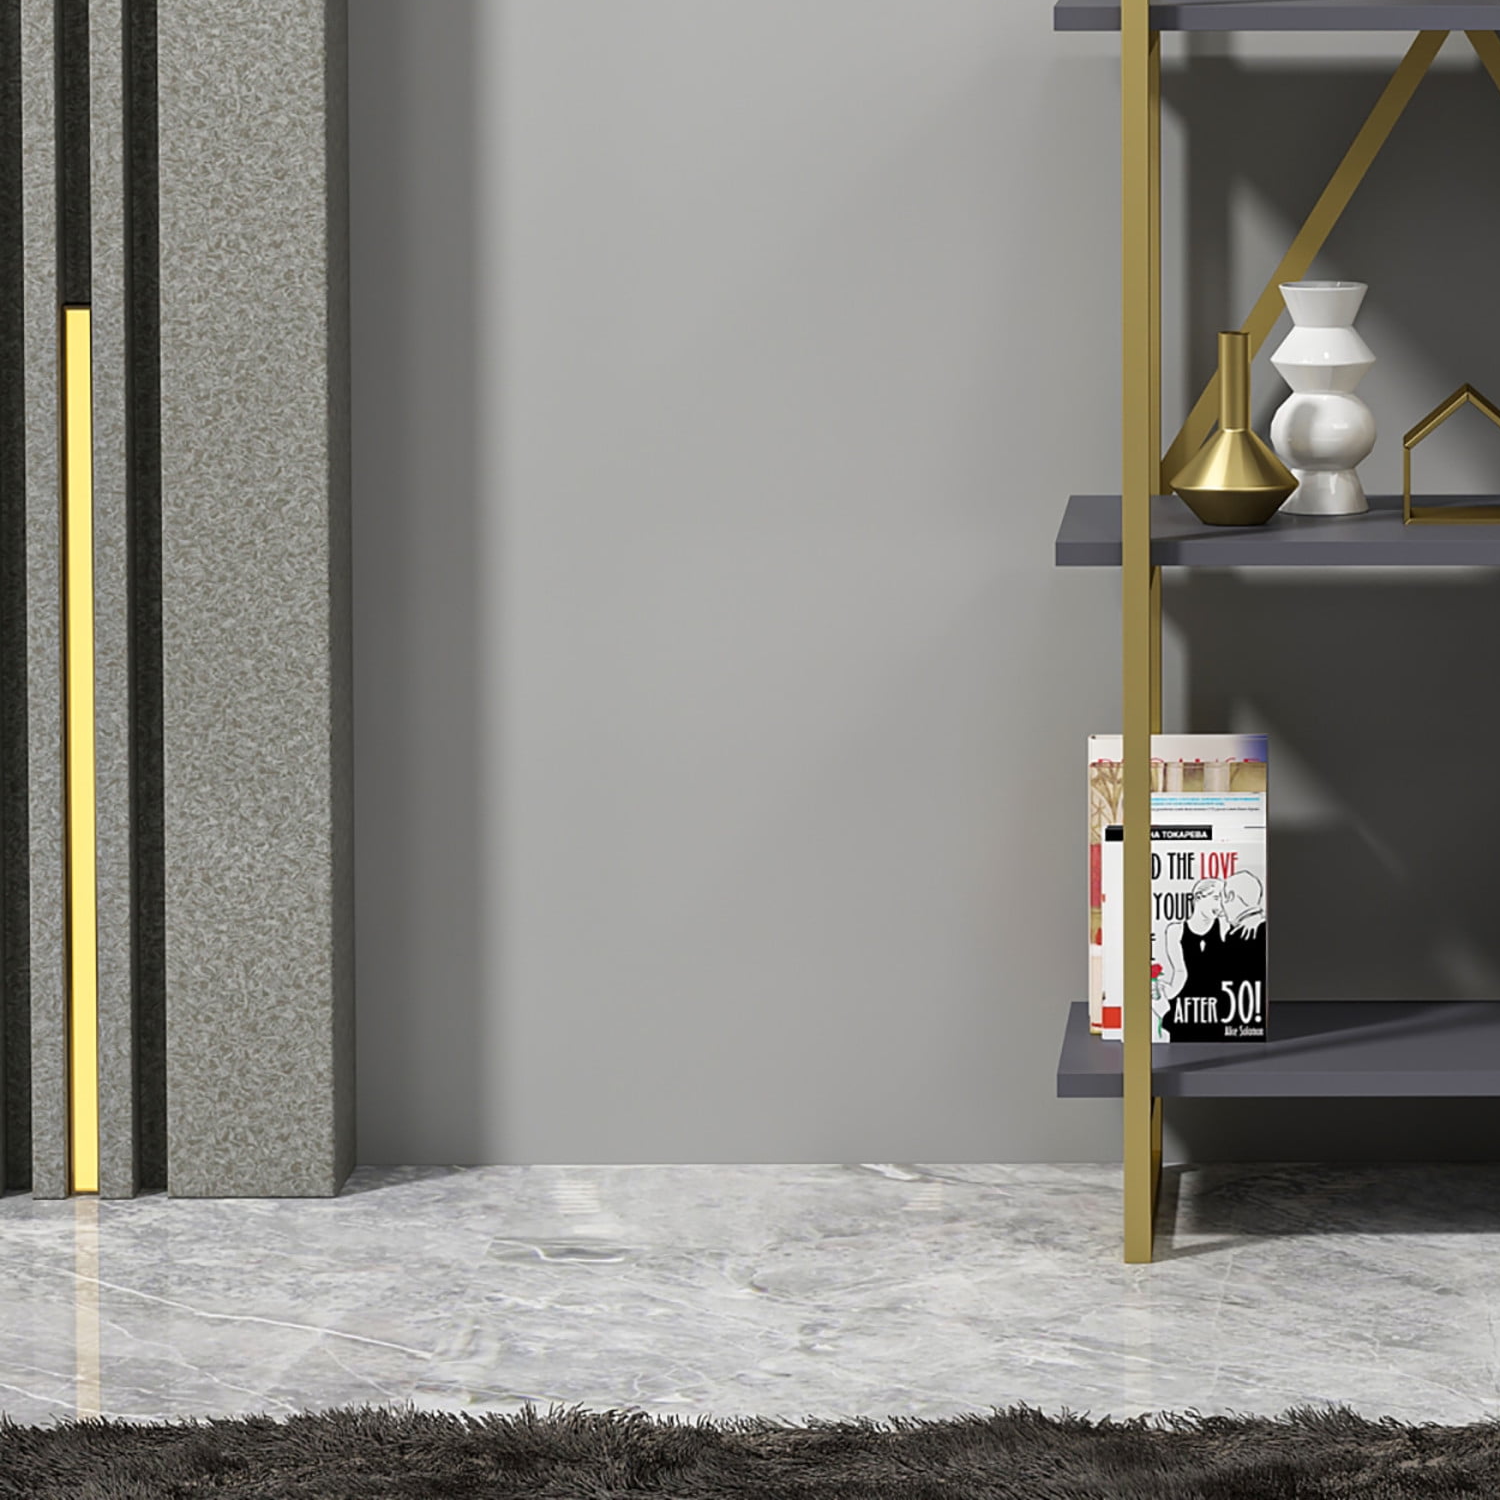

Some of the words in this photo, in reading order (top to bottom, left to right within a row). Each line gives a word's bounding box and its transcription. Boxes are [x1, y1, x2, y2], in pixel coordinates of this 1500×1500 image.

[1167, 852, 1195, 880] THE
[1200, 852, 1239, 880] LOVE
[1174, 997, 1218, 1023] AFTER
[1221, 980, 1262, 1023] 50!
